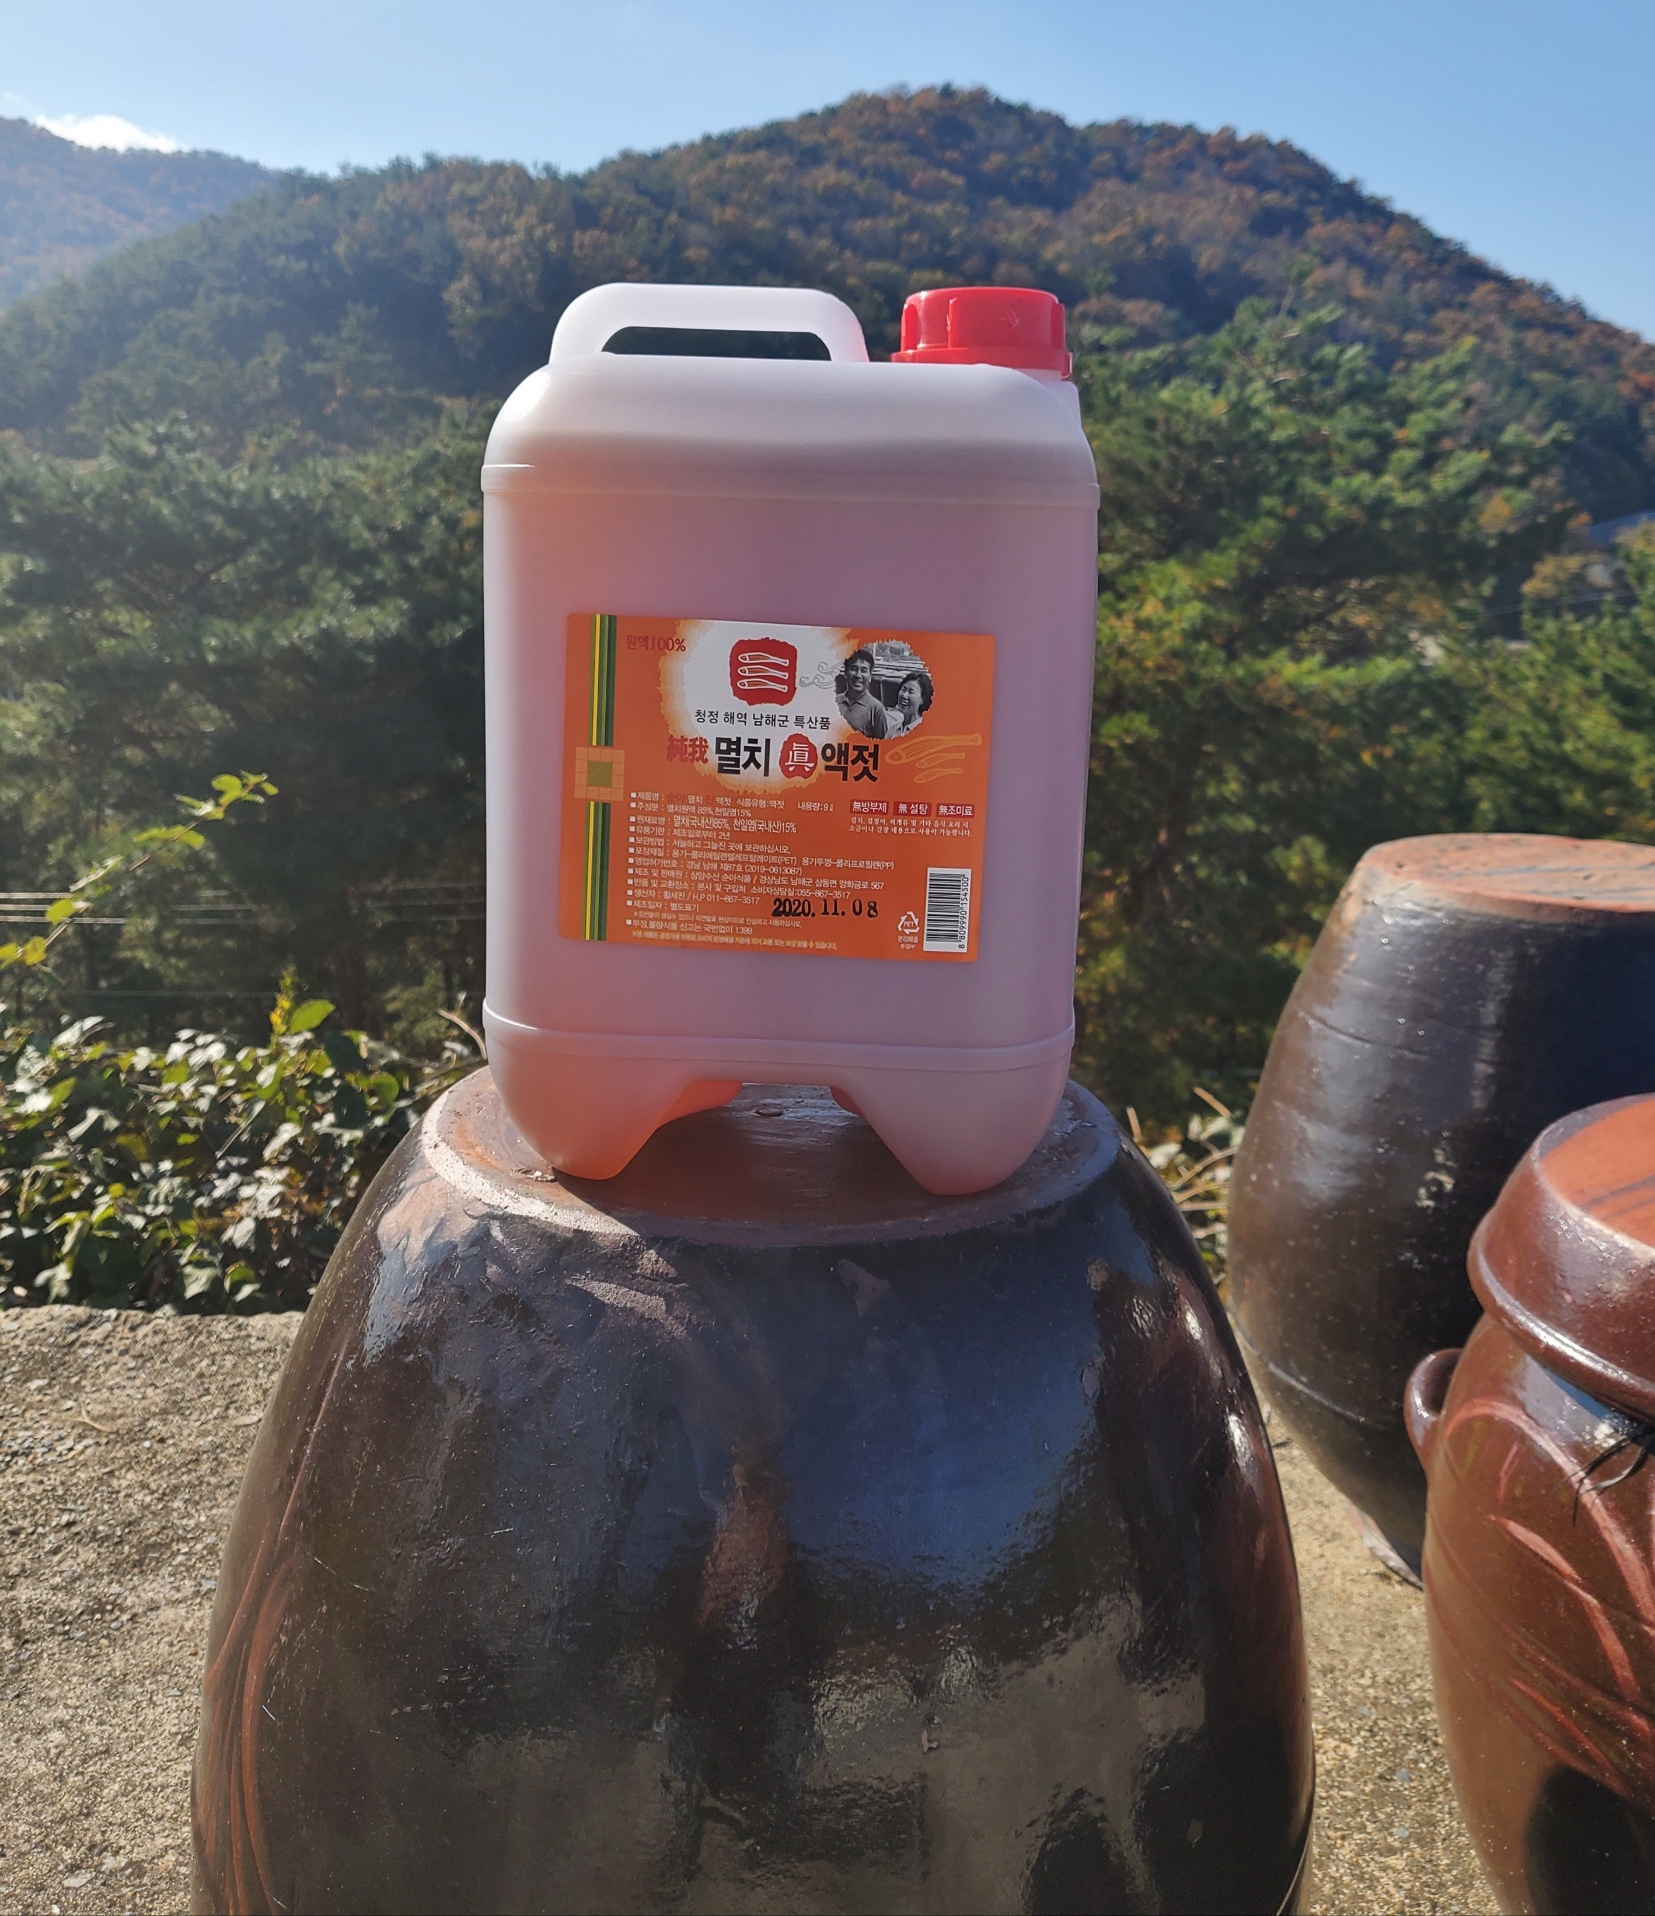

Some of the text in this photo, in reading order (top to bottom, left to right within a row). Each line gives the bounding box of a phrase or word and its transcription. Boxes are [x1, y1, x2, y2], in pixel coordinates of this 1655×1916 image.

[626, 635, 686, 652] 원액100%
[695, 709, 831, 730] 청정 해역 남해군 특산품
[715, 736, 771, 777] 멸치
[821, 742, 880, 783] 액젓
[688, 795, 703, 804] 멸치
[715, 796, 731, 806] 액젓
[667, 804, 695, 814] 멸치원액
[852, 801, 888, 814] 無방부제
[898, 803, 929, 816] 無 설탕
[938, 804, 973, 816] 無조미료
[849, 825, 874, 833] 소금이나
[919, 819, 932, 828] 기타
[934, 820, 946, 828] 음식
[870, 882, 885, 890] 567
[960, 877, 969, 906] 154500
[706, 893, 760, 904] 011-867-3517
[771, 897, 816, 918] 2020.
[821, 899, 846, 917] 11.
[735, 926, 753, 935] 1399
[959, 910, 968, 940] 809990
